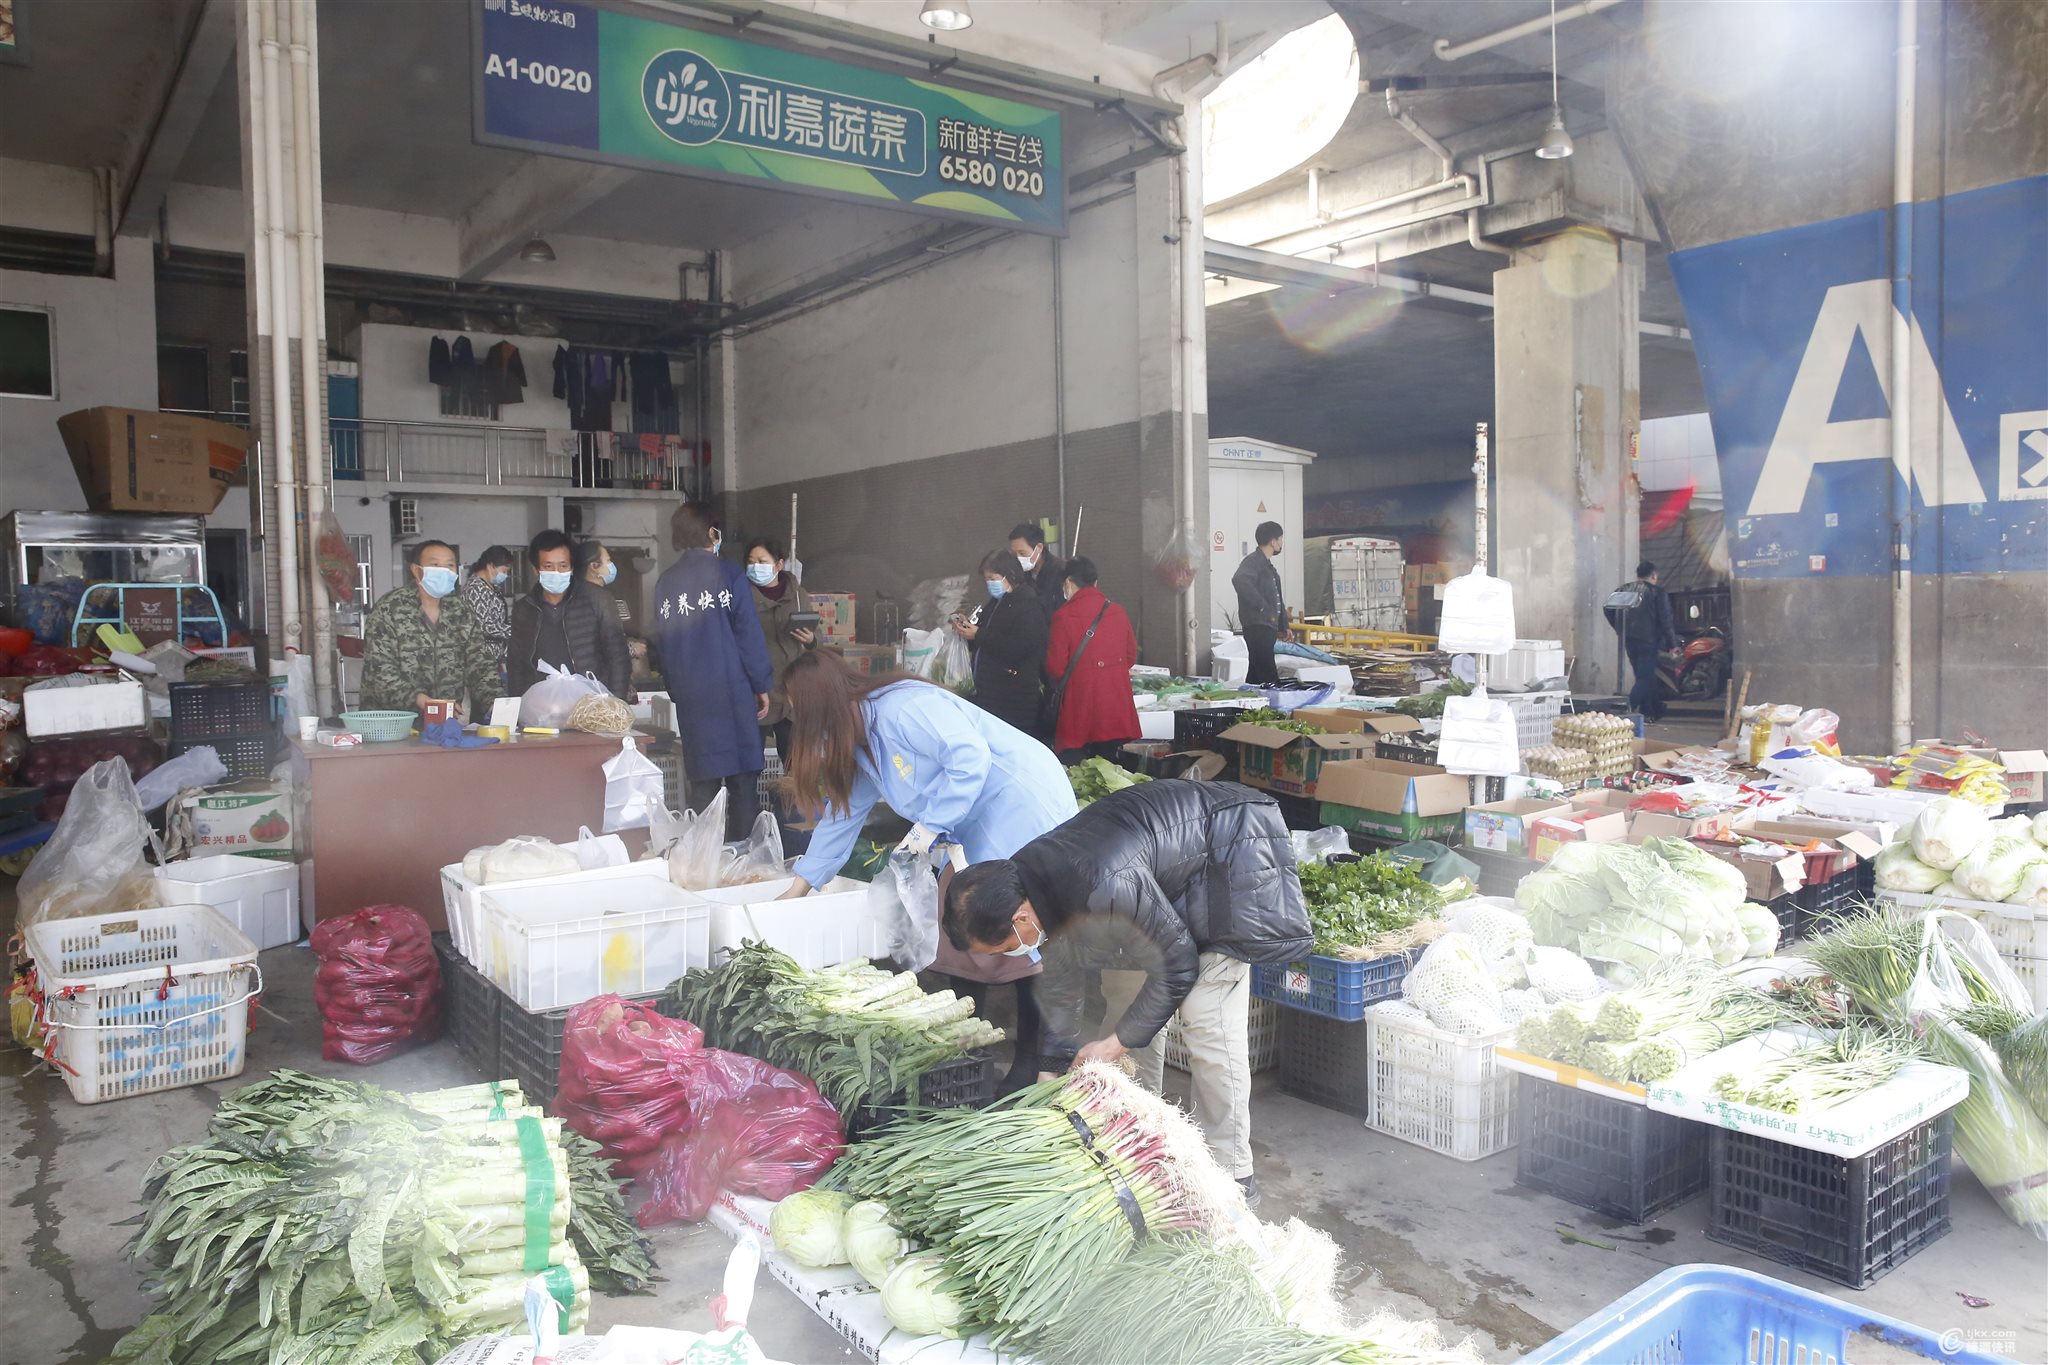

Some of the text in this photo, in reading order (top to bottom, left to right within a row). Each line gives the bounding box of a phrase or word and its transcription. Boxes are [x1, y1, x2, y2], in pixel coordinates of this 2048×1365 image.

[484, 53, 592, 94] A1-0020
[737, 83, 907, 162] 利嘉蔬菜
[939, 118, 1043, 168] 新鲜专线
[939, 155, 1044, 196] 6580 020
[660, 588, 733, 620] 营养快线
[201, 835, 248, 845] 宏兴精品
